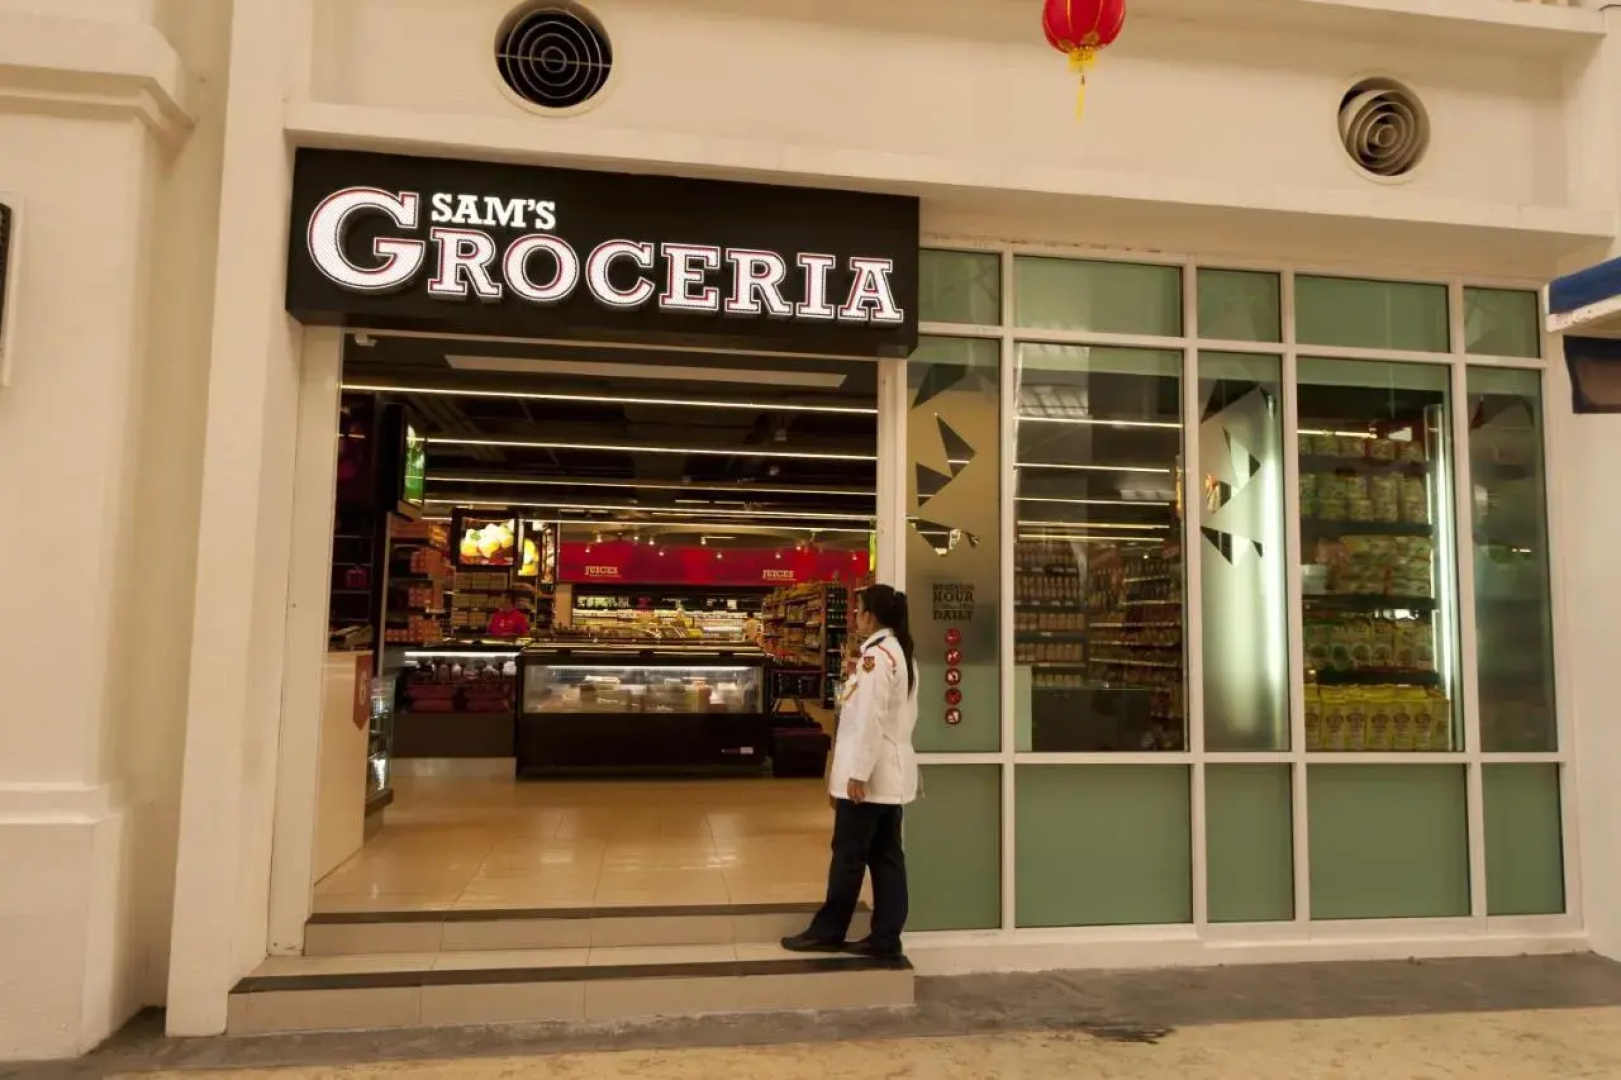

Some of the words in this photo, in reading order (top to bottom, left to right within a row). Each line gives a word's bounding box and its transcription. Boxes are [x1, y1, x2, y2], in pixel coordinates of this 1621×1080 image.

[431, 192, 556, 230] SAM'S
[307, 186, 904, 324] GROCERIA
[585, 565, 618, 576] JUICES
[762, 569, 795, 579] JUICES
[932, 590, 975, 602] HOUR
[932, 609, 974, 621] DAILY
